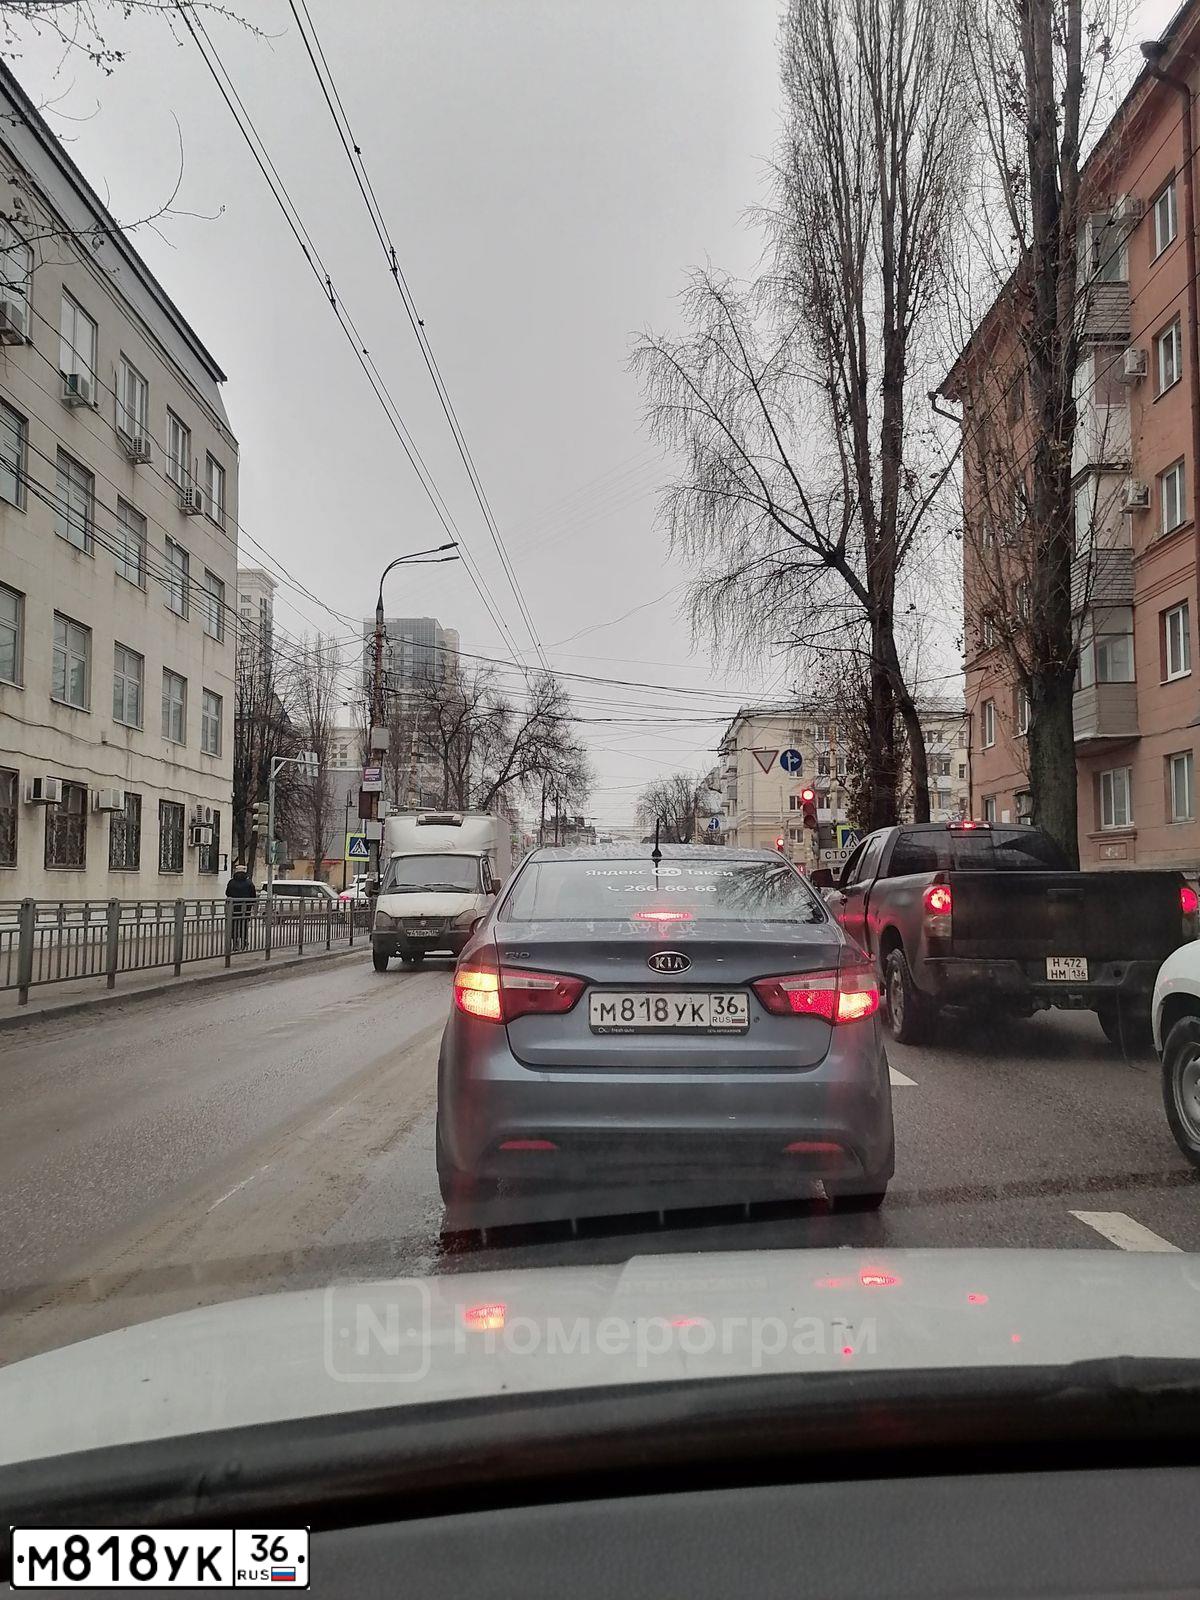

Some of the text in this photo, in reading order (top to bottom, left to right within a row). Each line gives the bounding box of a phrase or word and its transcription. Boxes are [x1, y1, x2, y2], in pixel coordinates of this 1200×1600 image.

[686, 868, 734, 877] Такси
[623, 884, 718, 892] 266-66-66
[655, 956, 684, 969] KIA
[1063, 958, 1081, 967] 472
[713, 996, 739, 1015] 36
[712, 1016, 731, 1024] RUS
